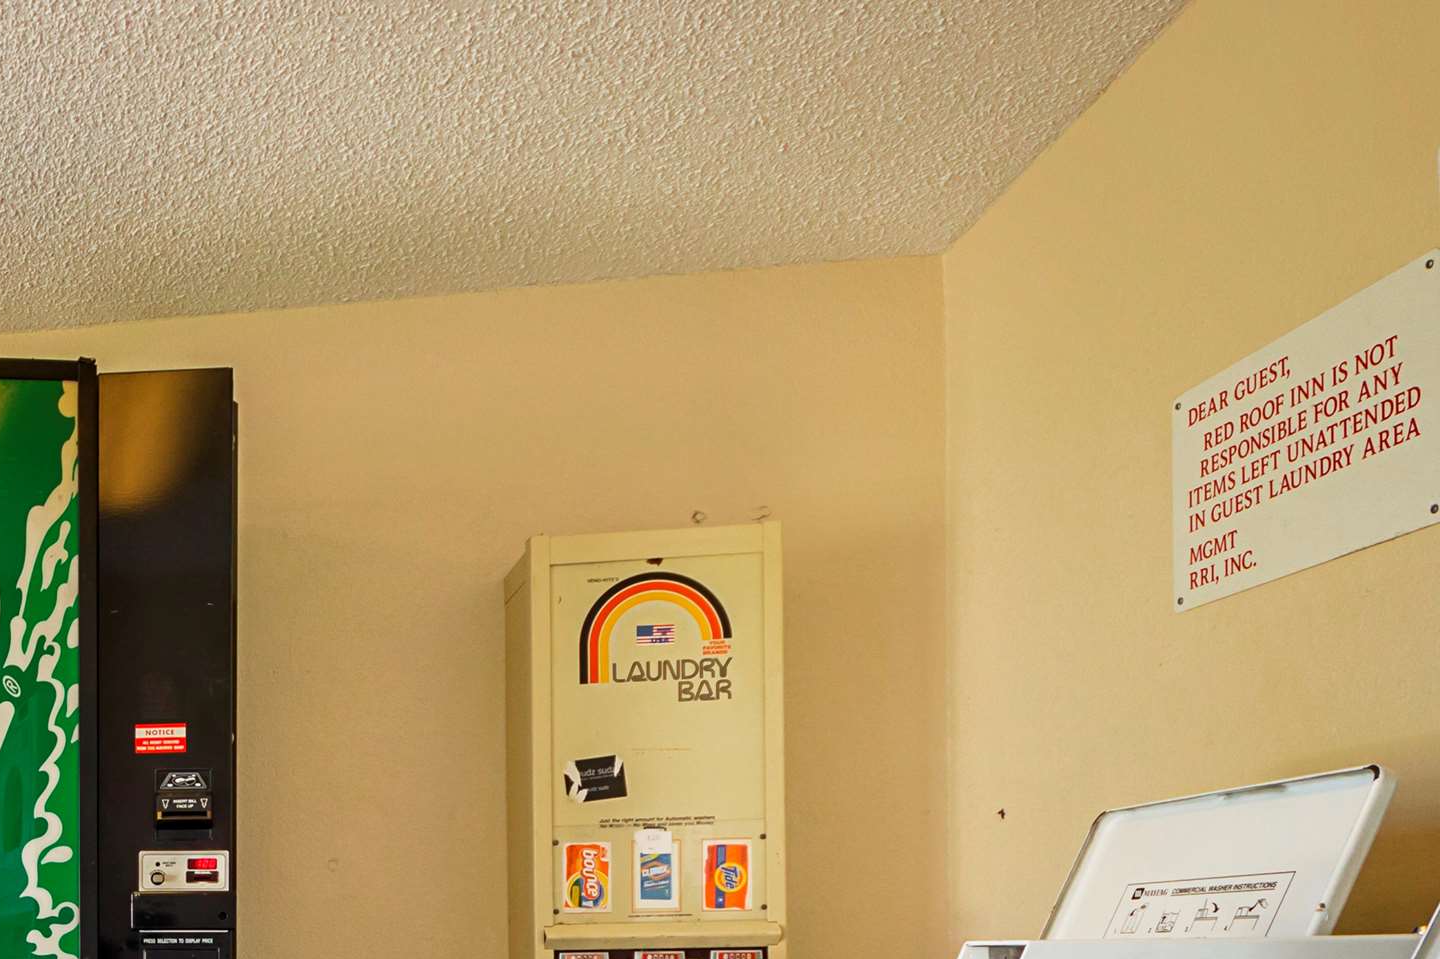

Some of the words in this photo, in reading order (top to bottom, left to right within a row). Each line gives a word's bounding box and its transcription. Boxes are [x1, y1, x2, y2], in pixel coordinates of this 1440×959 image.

[1188, 390, 1229, 428] DEAR
[1234, 356, 1291, 402] GUEST,
[1203, 422, 1234, 452] RED
[1239, 395, 1285, 434] ROOF
[1291, 373, 1326, 408] INN
[1332, 361, 1348, 388] IS
[1355, 335, 1398, 375] NOT
[1200, 410, 1307, 478] RESPONSIBLE
[1313, 390, 1350, 424] FOR
[1357, 362, 1404, 403] ANY
[1188, 471, 1236, 508] ITEMS
[1241, 450, 1281, 485] LEFT
[1287, 386, 1422, 463] UNATTENDED
[1189, 511, 1206, 533] IN
[1210, 485, 1262, 524] GUEST
[1269, 444, 1354, 499] LAUNDRY
[1362, 417, 1421, 460] AREA
[1189, 530, 1238, 566] MGMT
[1189, 563, 1220, 591] RRI,
[1224, 550, 1257, 577] INC.
[612, 657, 733, 683] LAUNDRY
[678, 679, 732, 702] BAR
[721, 866, 738, 889] Tide
[1172, 886, 1206, 895] COMMERCIAL
[1208, 883, 1232, 893] WASHER
[1233, 881, 1277, 891] INSTRUCTIONS
